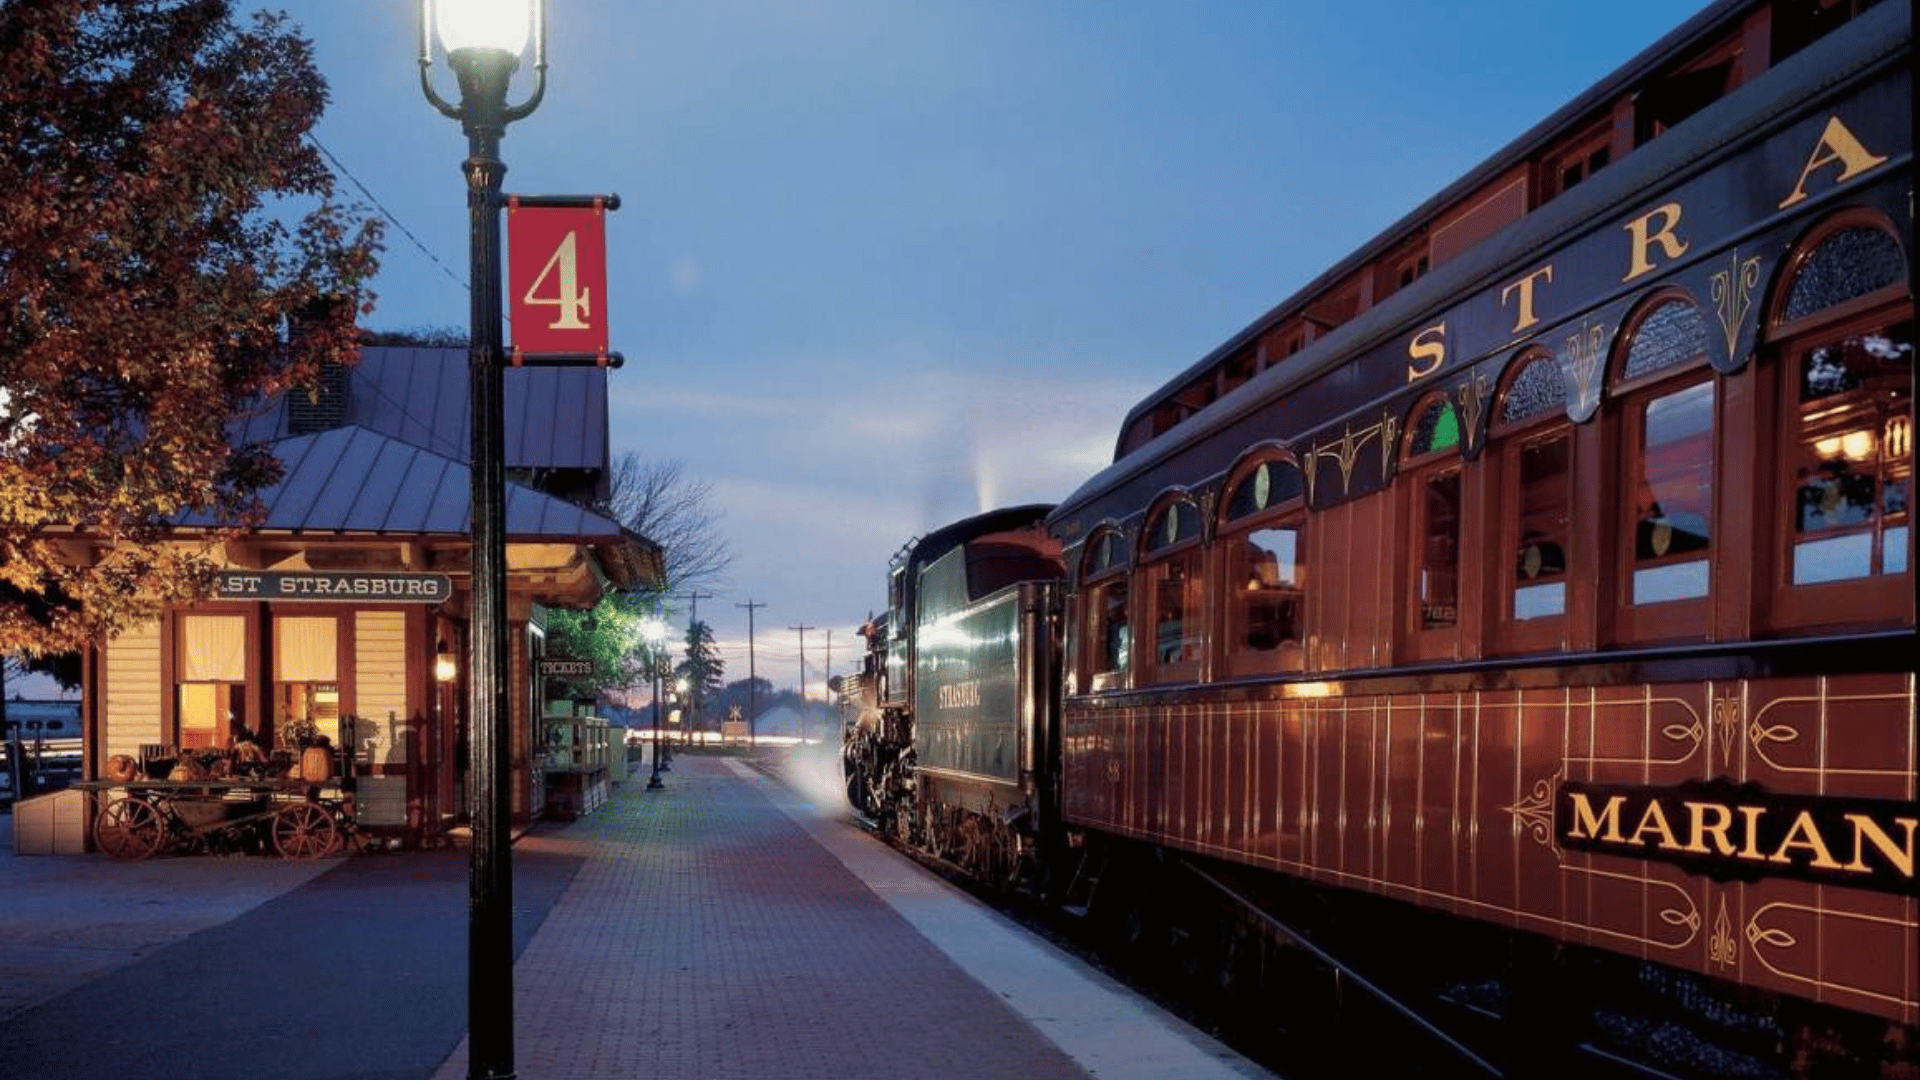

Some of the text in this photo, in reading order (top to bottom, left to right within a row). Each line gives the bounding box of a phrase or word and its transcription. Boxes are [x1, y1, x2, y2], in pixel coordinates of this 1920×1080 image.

[1408, 115, 1889, 382] STRA
[523, 230, 590, 329] 4
[279, 576, 439, 596] STRASBURG
[540, 661, 591, 674] TICKETS
[939, 680, 980, 710] STRASBURG
[1568, 791, 1919, 878] MARIAN
